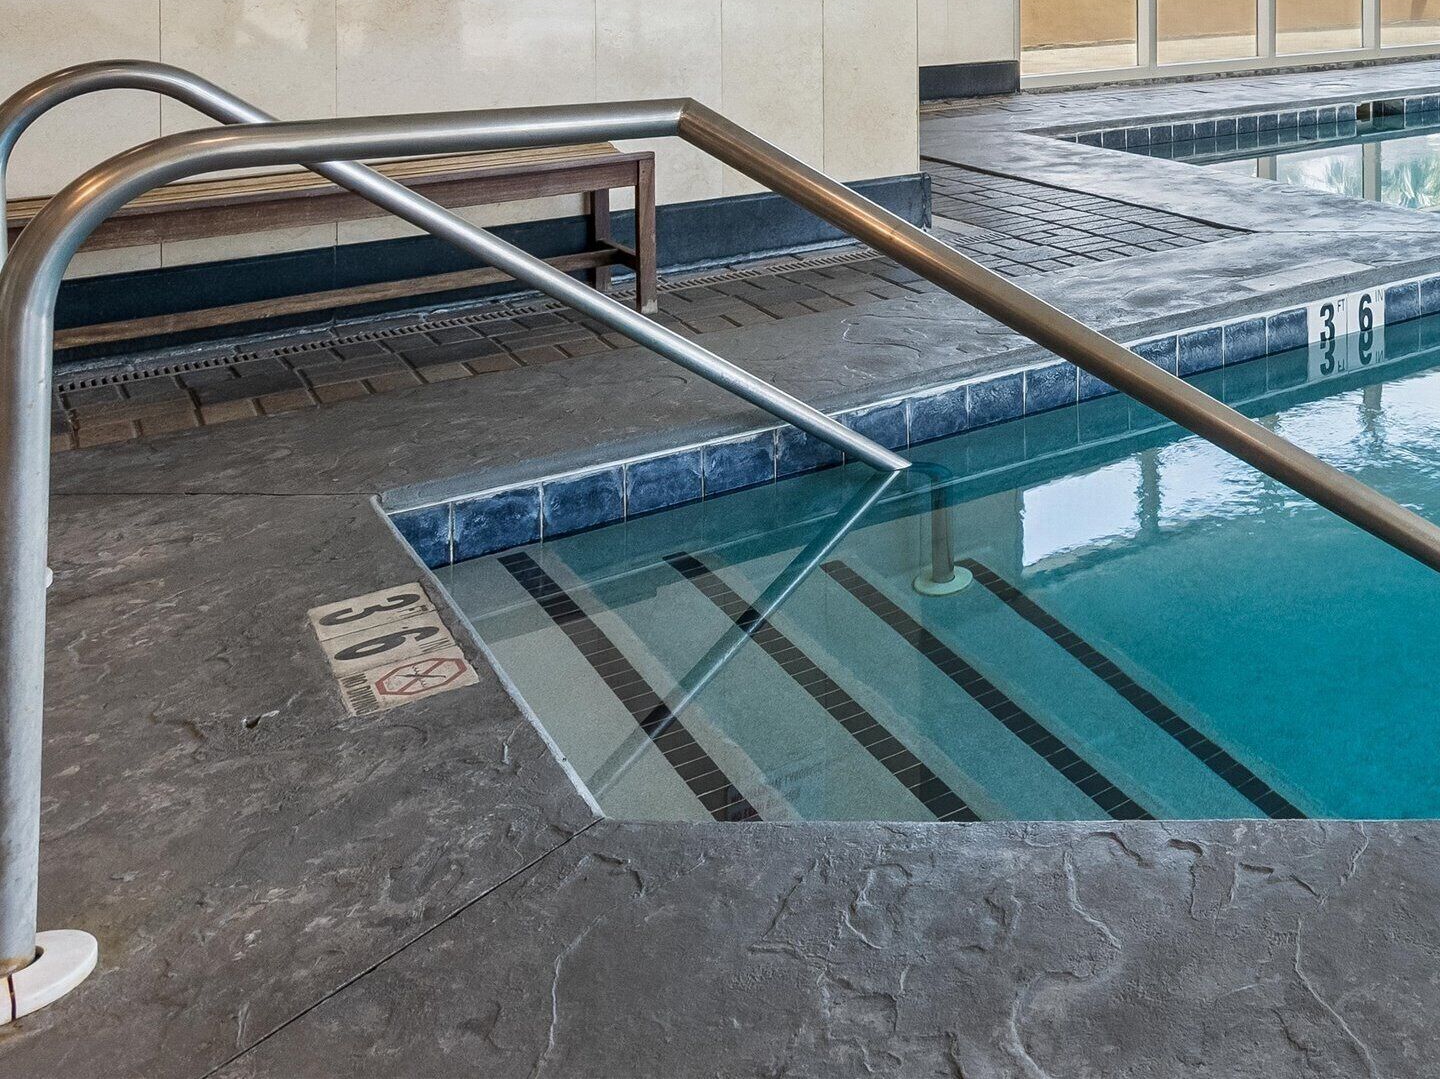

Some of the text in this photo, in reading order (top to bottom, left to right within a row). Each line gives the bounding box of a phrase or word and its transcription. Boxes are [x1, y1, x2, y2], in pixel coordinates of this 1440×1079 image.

[1320, 289, 1383, 341] 3 FT 6 IN
[319, 593, 420, 626] 3
[334, 626, 440, 660] 6
[340, 673, 380, 715] NO DIVING
